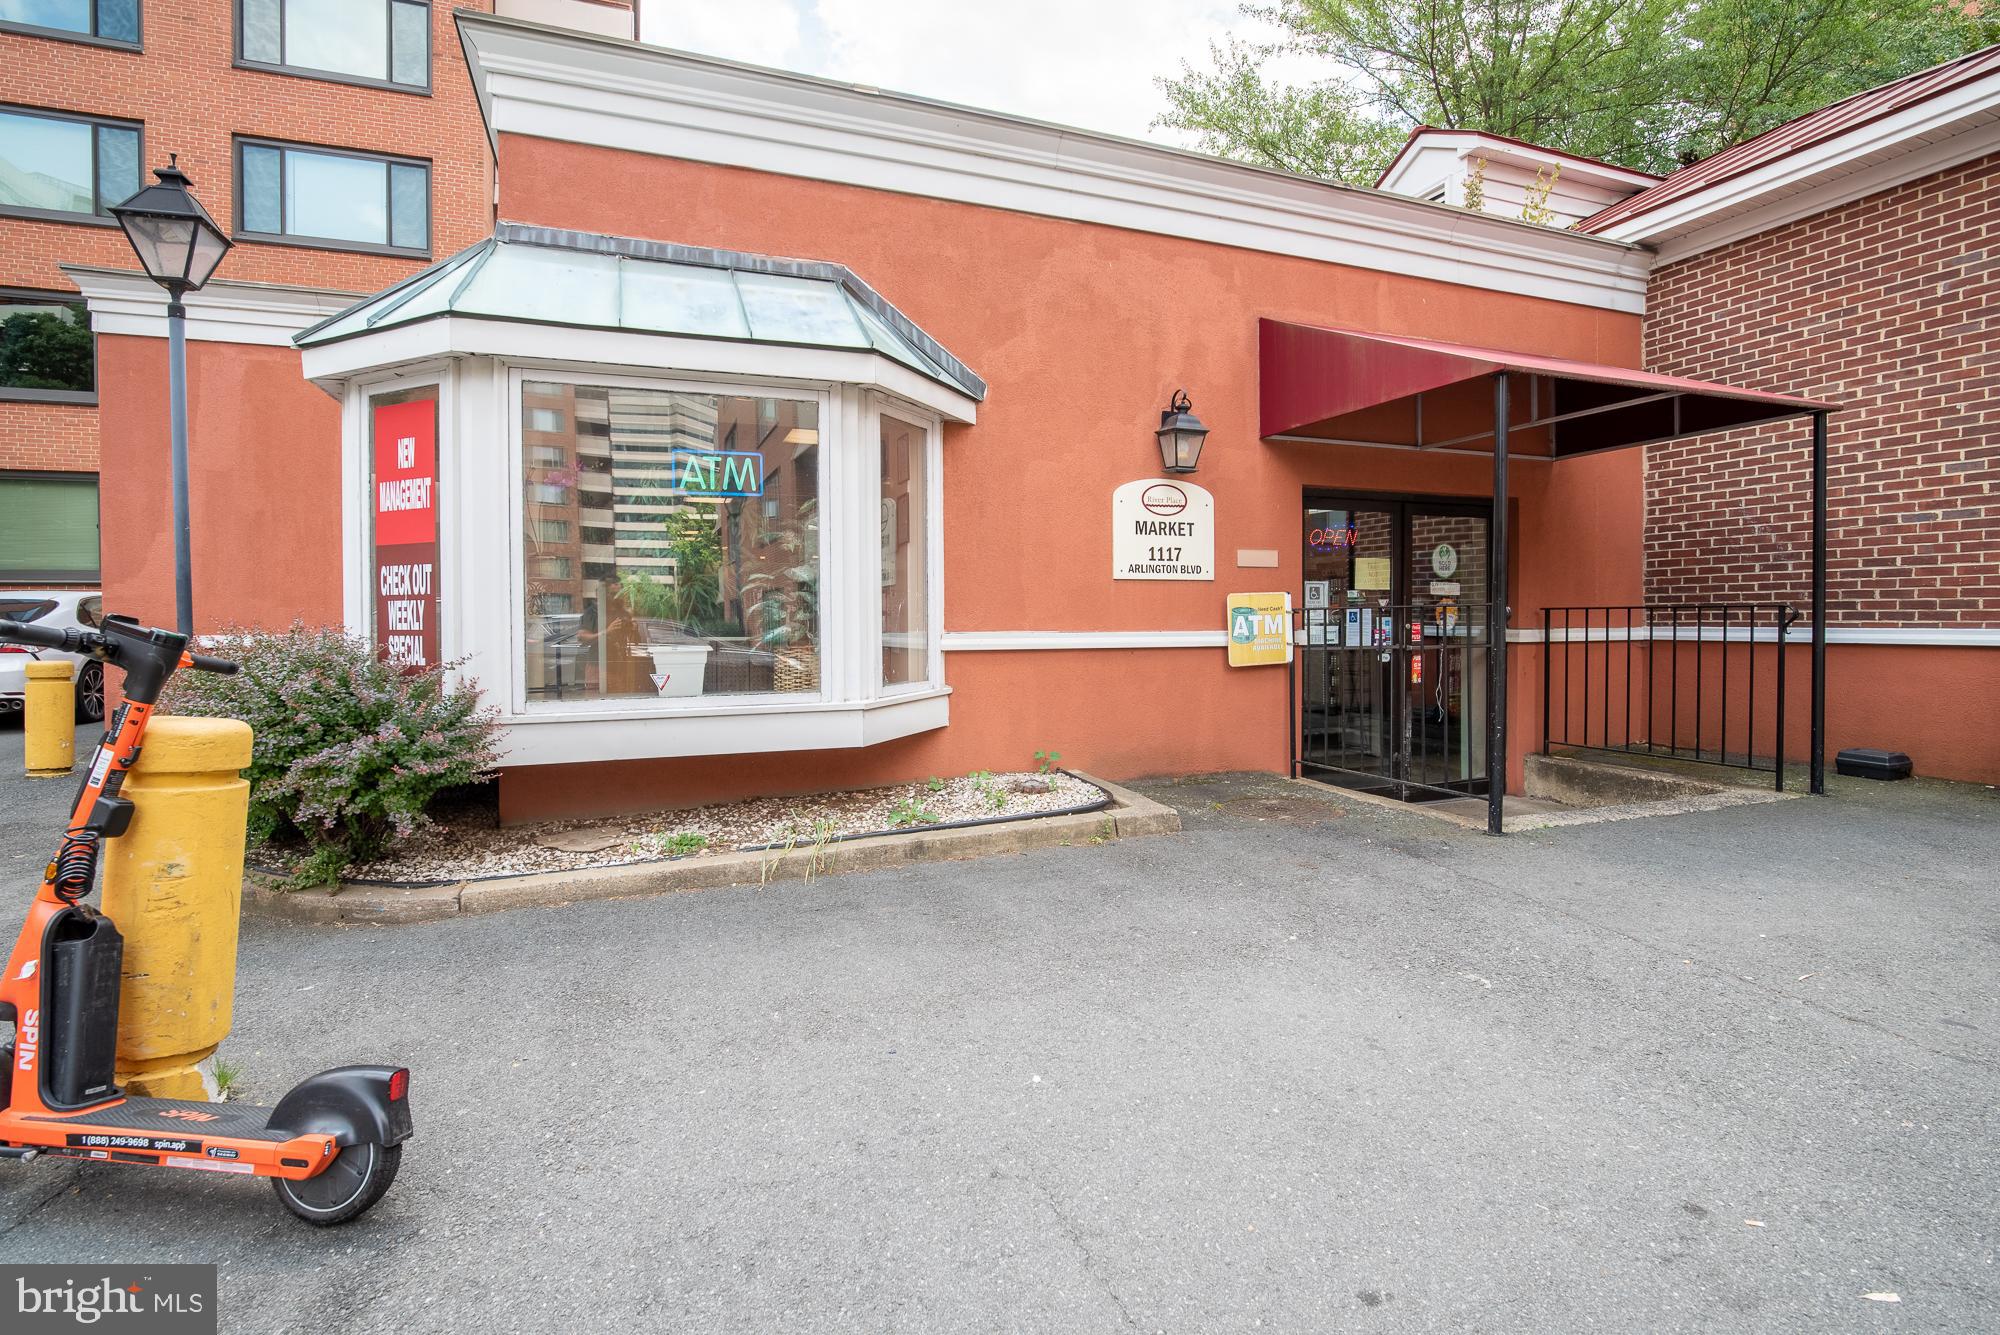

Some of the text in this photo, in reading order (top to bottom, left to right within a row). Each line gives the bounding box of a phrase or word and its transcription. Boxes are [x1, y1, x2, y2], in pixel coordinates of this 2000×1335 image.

[397, 437, 416, 469] NEW
[680, 455, 756, 491] ATM
[379, 477, 431, 513] MANAGEMENT
[1135, 520, 1195, 537] MARKET
[1309, 528, 1359, 546] OPEN
[1128, 563, 1202, 575] ARLINGTON BLVD
[1148, 546, 1182, 562] 1117
[380, 564, 432, 597] CHECK OUT
[388, 600, 425, 631] WEEKLY
[1233, 614, 1283, 637] ATM
[388, 635, 426, 666] SPECIAL
[18, 1009, 39, 1071] SPIN
[81, 1135, 186, 1151] 1 (888) 249-9698 spin.app
